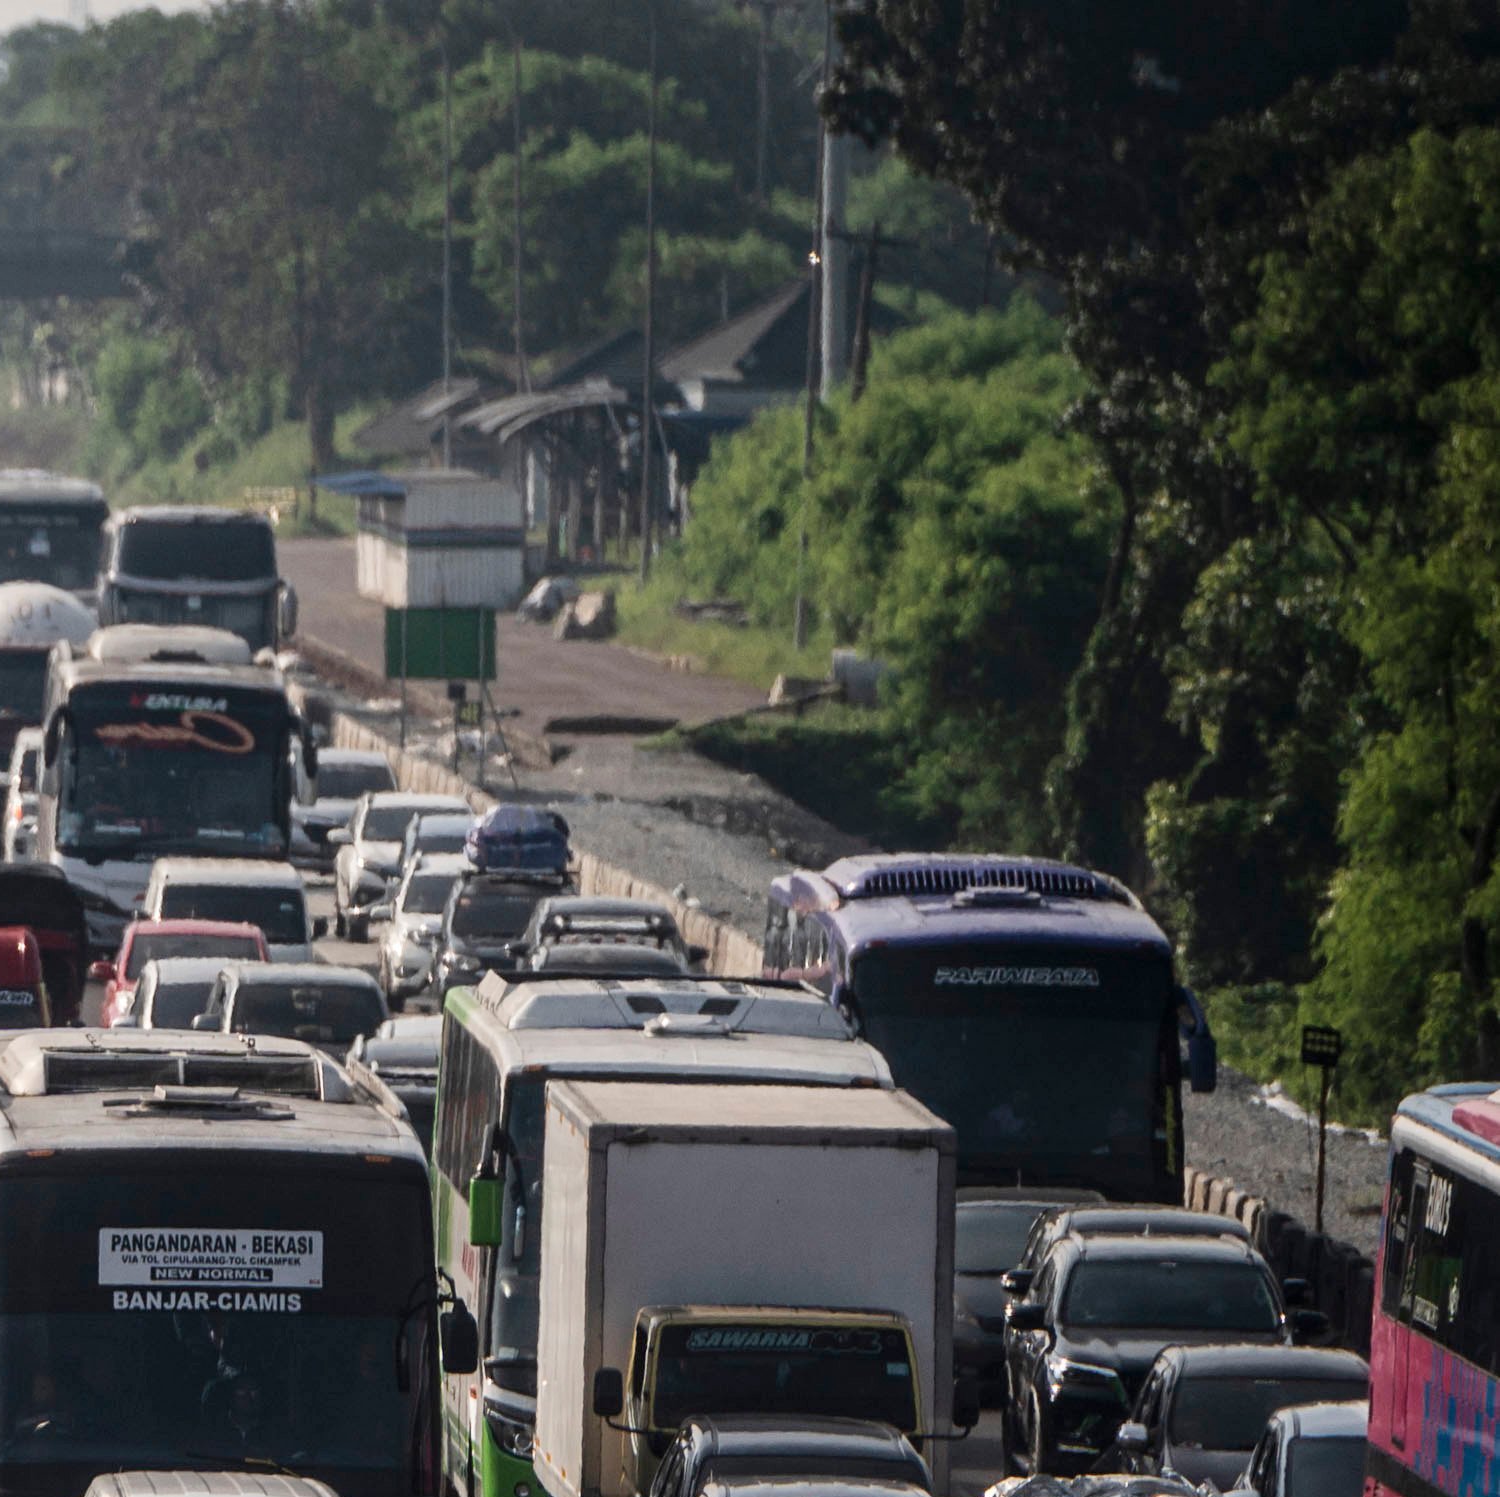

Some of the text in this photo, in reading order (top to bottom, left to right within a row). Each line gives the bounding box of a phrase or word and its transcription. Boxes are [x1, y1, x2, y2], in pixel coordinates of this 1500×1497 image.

[934, 966, 1099, 986] PARIWISATA
[111, 1233, 237, 1253] PANGANDARAN
[252, 1235, 313, 1255] BEKASI
[121, 1255, 138, 1264] VIA
[141, 1255, 158, 1265] TOL
[249, 1256, 301, 1266] CIKAMPEK
[155, 1268, 270, 1281] NEW NORMAL
[112, 1290, 302, 1312] BANJAR-CIAMIS
[689, 1329, 812, 1349] SAWARNA
